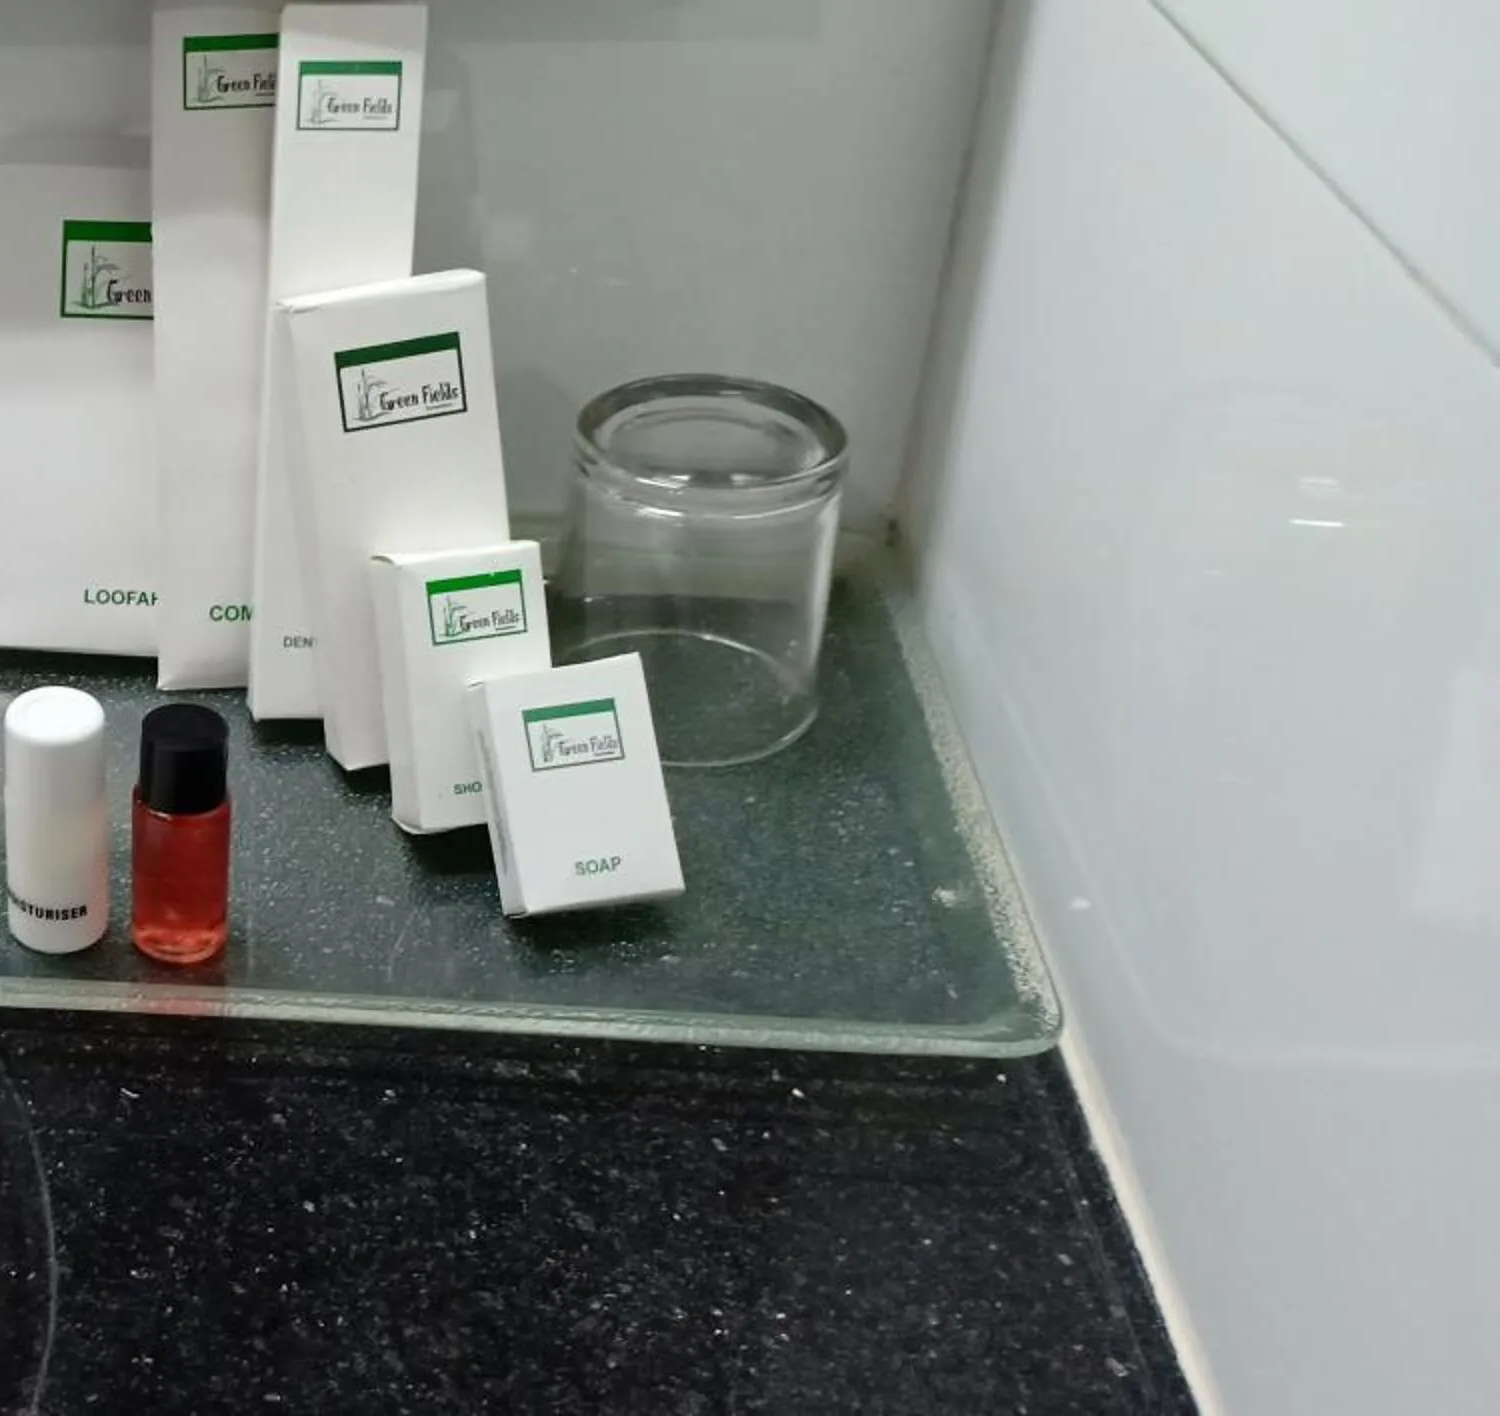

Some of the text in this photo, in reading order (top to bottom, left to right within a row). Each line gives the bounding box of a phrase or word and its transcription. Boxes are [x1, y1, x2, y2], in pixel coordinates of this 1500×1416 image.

[217, 75, 251, 92] Green
[326, 97, 392, 113] Green Fields
[107, 279, 151, 303] Green
[379, 382, 459, 411] Green Fields
[458, 608, 520, 632] Green Fields
[558, 741, 589, 756] Green
[574, 856, 621, 876] SOAP
